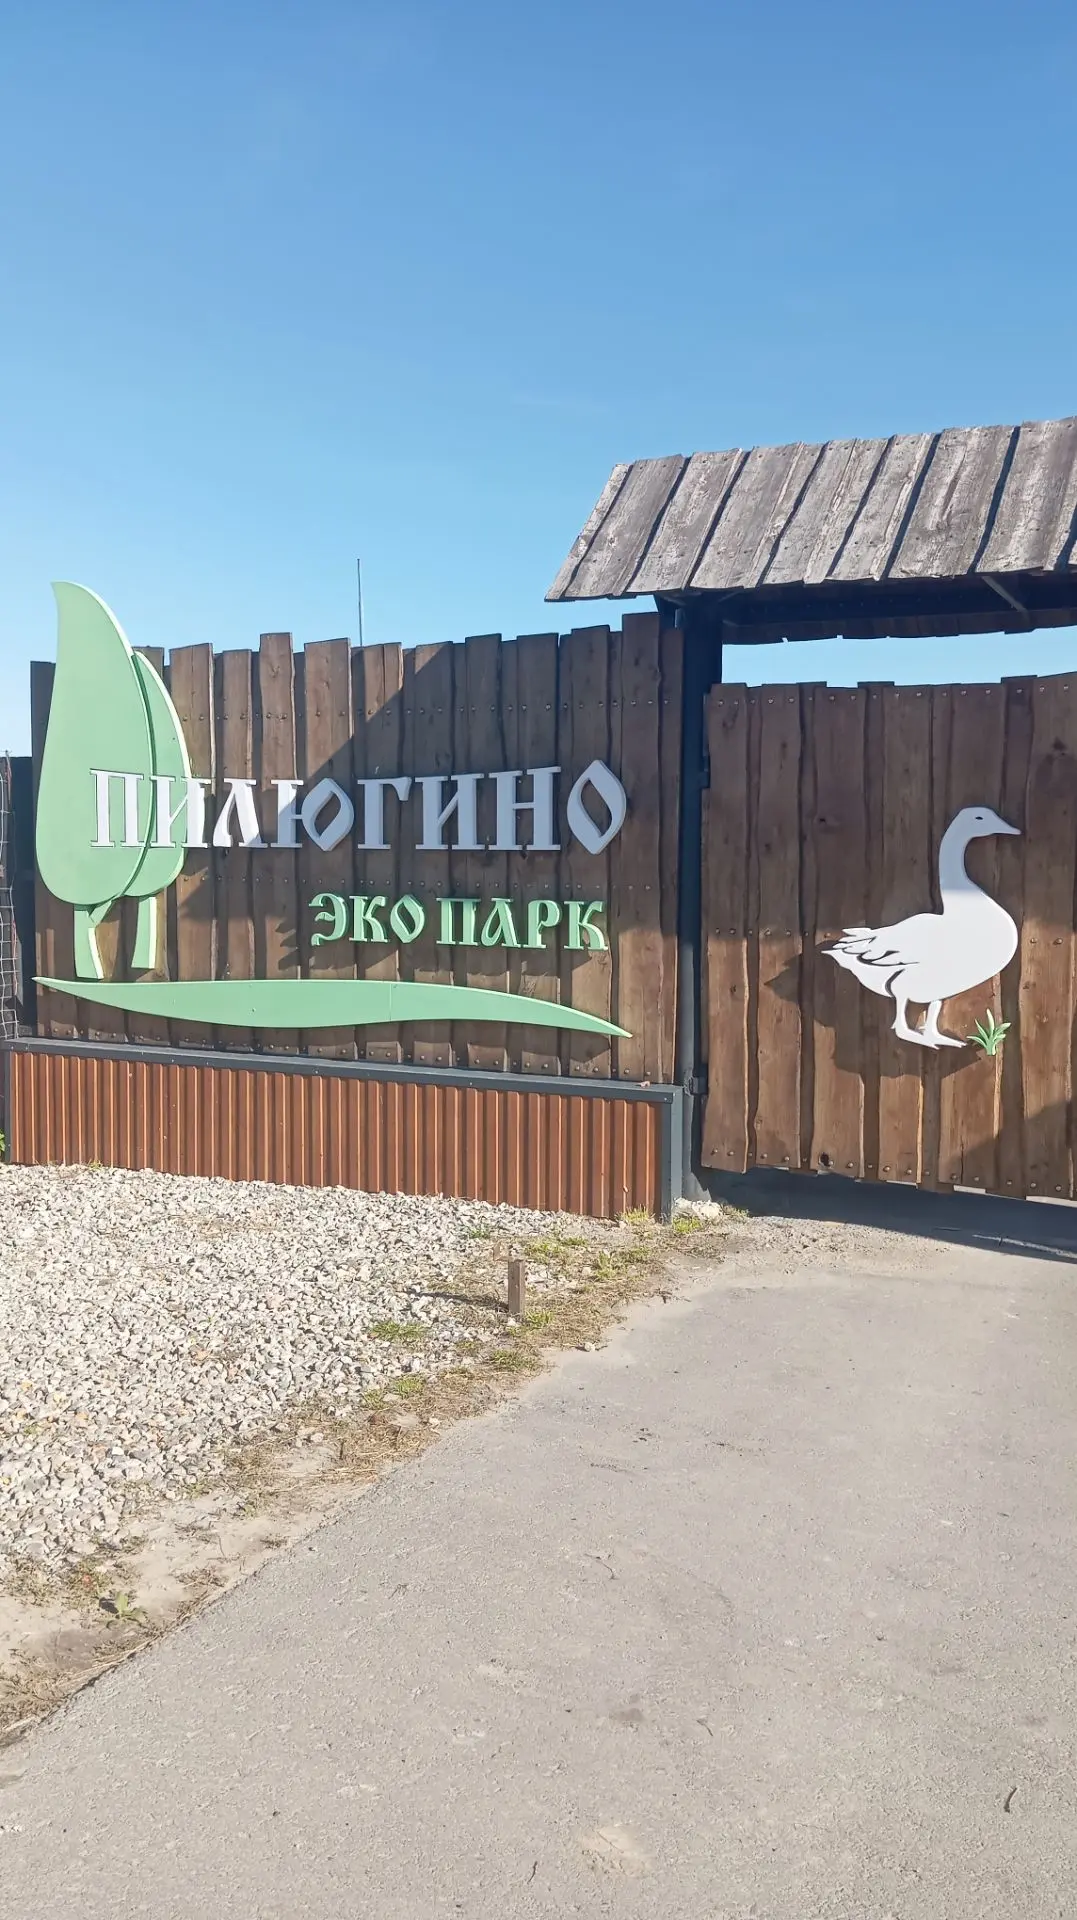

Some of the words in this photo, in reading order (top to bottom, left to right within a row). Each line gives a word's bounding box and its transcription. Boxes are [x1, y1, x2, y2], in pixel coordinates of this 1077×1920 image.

[90, 760, 627, 855] ПИЛЮГИНО
[310, 892, 425, 947] ЭКО
[436, 897, 609, 950] ПАРК
